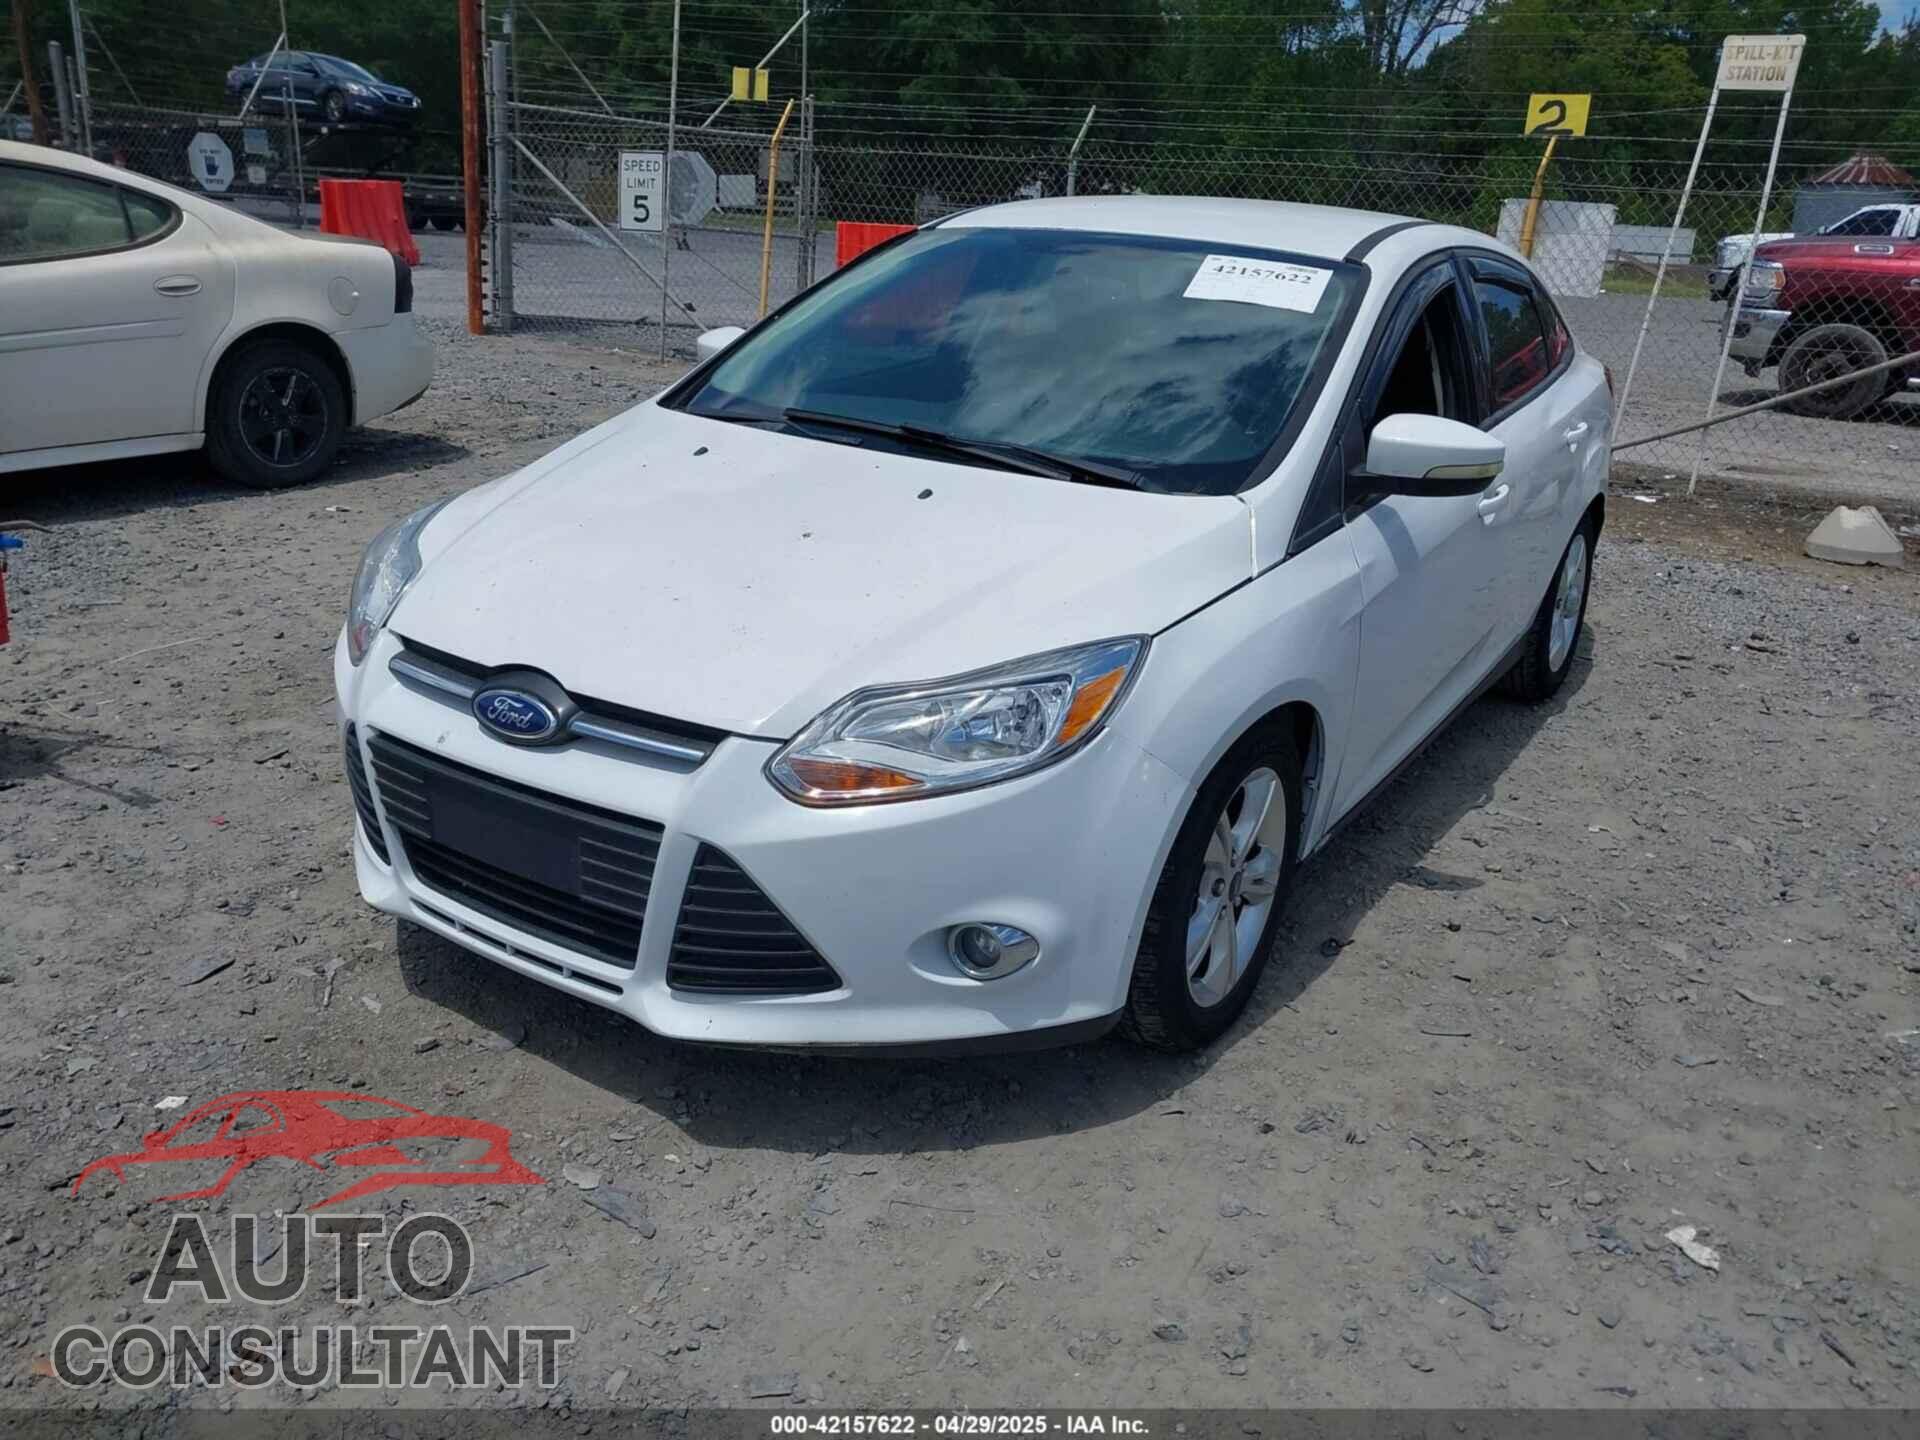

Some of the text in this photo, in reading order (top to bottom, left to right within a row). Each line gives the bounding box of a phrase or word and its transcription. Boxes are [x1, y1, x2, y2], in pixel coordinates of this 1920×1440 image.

[1726, 65, 1787, 81] STATION
[1529, 99, 1574, 135] 2
[623, 159, 661, 172] SPEED
[626, 178, 656, 189] LIMIT
[633, 195, 650, 223] 5
[1213, 264, 1312, 284] 42157622
[487, 696, 534, 728] Ford
